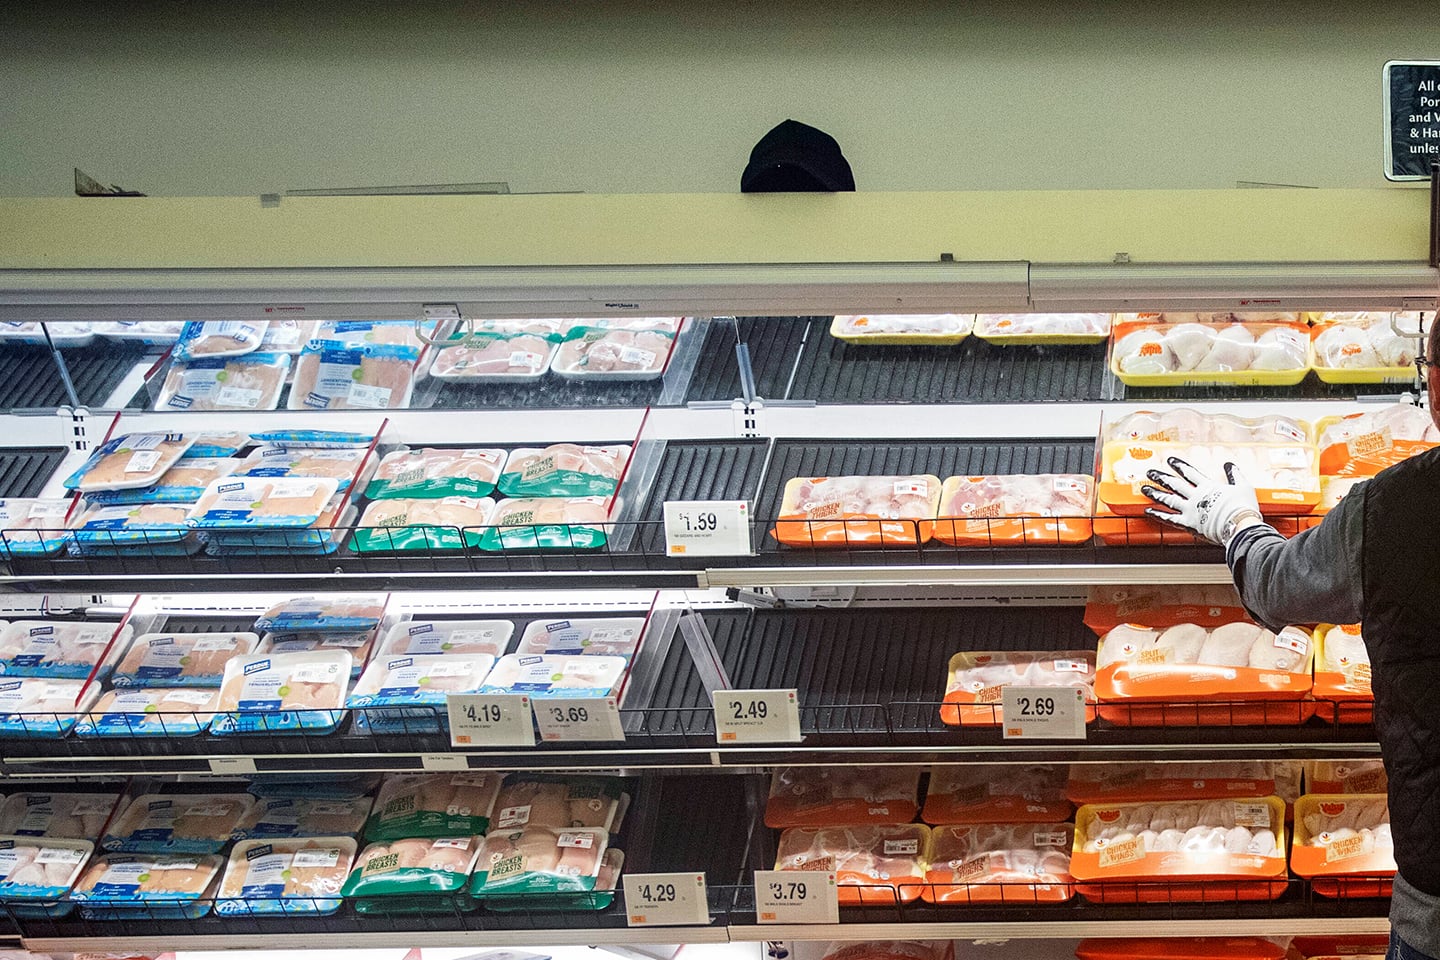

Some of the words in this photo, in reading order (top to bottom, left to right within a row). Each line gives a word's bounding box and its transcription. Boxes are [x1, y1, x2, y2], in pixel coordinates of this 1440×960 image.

[1418, 80, 1435, 92] All
[1408, 112, 1431, 123] and
[1410, 128, 1419, 139] &
[810, 502, 841, 514] CHICKEN
[969, 503, 1001, 516] CHICKEN
[545, 621, 571, 633] PERDUE
[243, 659, 271, 675] PERDUE
[387, 658, 413, 670] PERDUE
[518, 655, 543, 667] PERDUE
[462, 703, 501, 722] $4.19
[729, 701, 768, 719] $2.49
[1017, 697, 1055, 715] $2.69
[549, 707, 589, 722] $3.69
[1106, 840, 1138, 857] CHICKEN
[1332, 836, 1363, 852] CHICKEN
[1335, 844, 1361, 857] WINGS
[367, 853, 399, 867] CHICKEN
[1109, 849, 1135, 862] WINGS
[365, 859, 399, 873] BREASTS
[491, 862, 524, 878] BREASTS
[493, 855, 524, 871] CHICKEN
[638, 884, 675, 902] $4.29
[769, 883, 807, 900] $3.79
